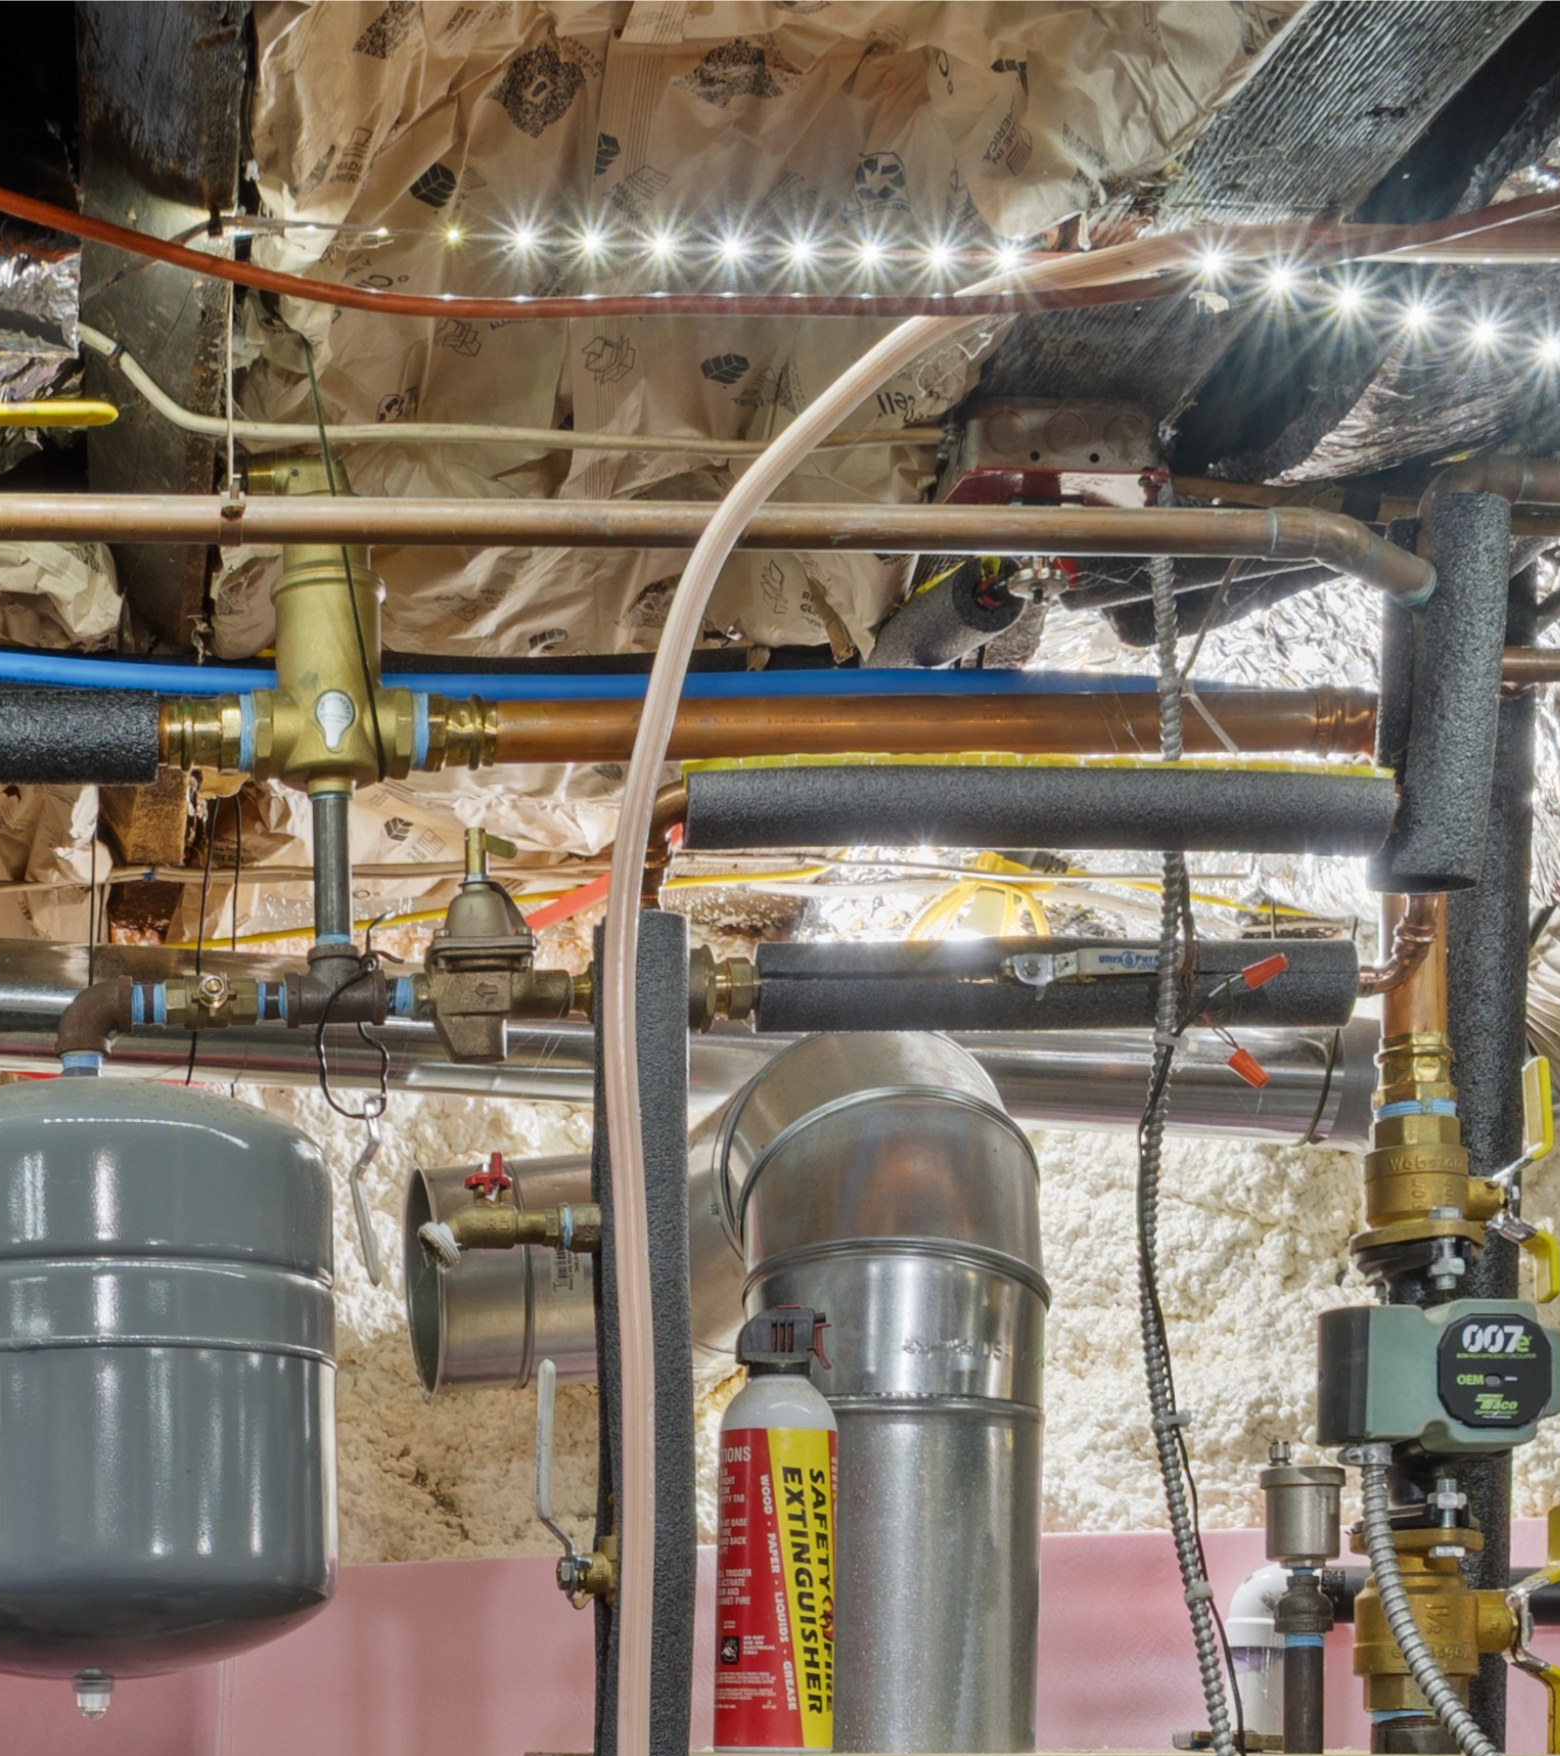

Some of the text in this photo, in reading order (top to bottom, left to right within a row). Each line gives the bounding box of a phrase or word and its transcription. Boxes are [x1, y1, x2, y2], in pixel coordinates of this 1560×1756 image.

[1098, 955, 1123, 963] Ultra
[1456, 1374, 1484, 1385] OEM
[782, 1466, 823, 1714] EXTINGUISHER
[809, 1468, 831, 1592] SAFETY
[760, 1474, 797, 1711] WOOD PAPER LIQUIDS GREASE
